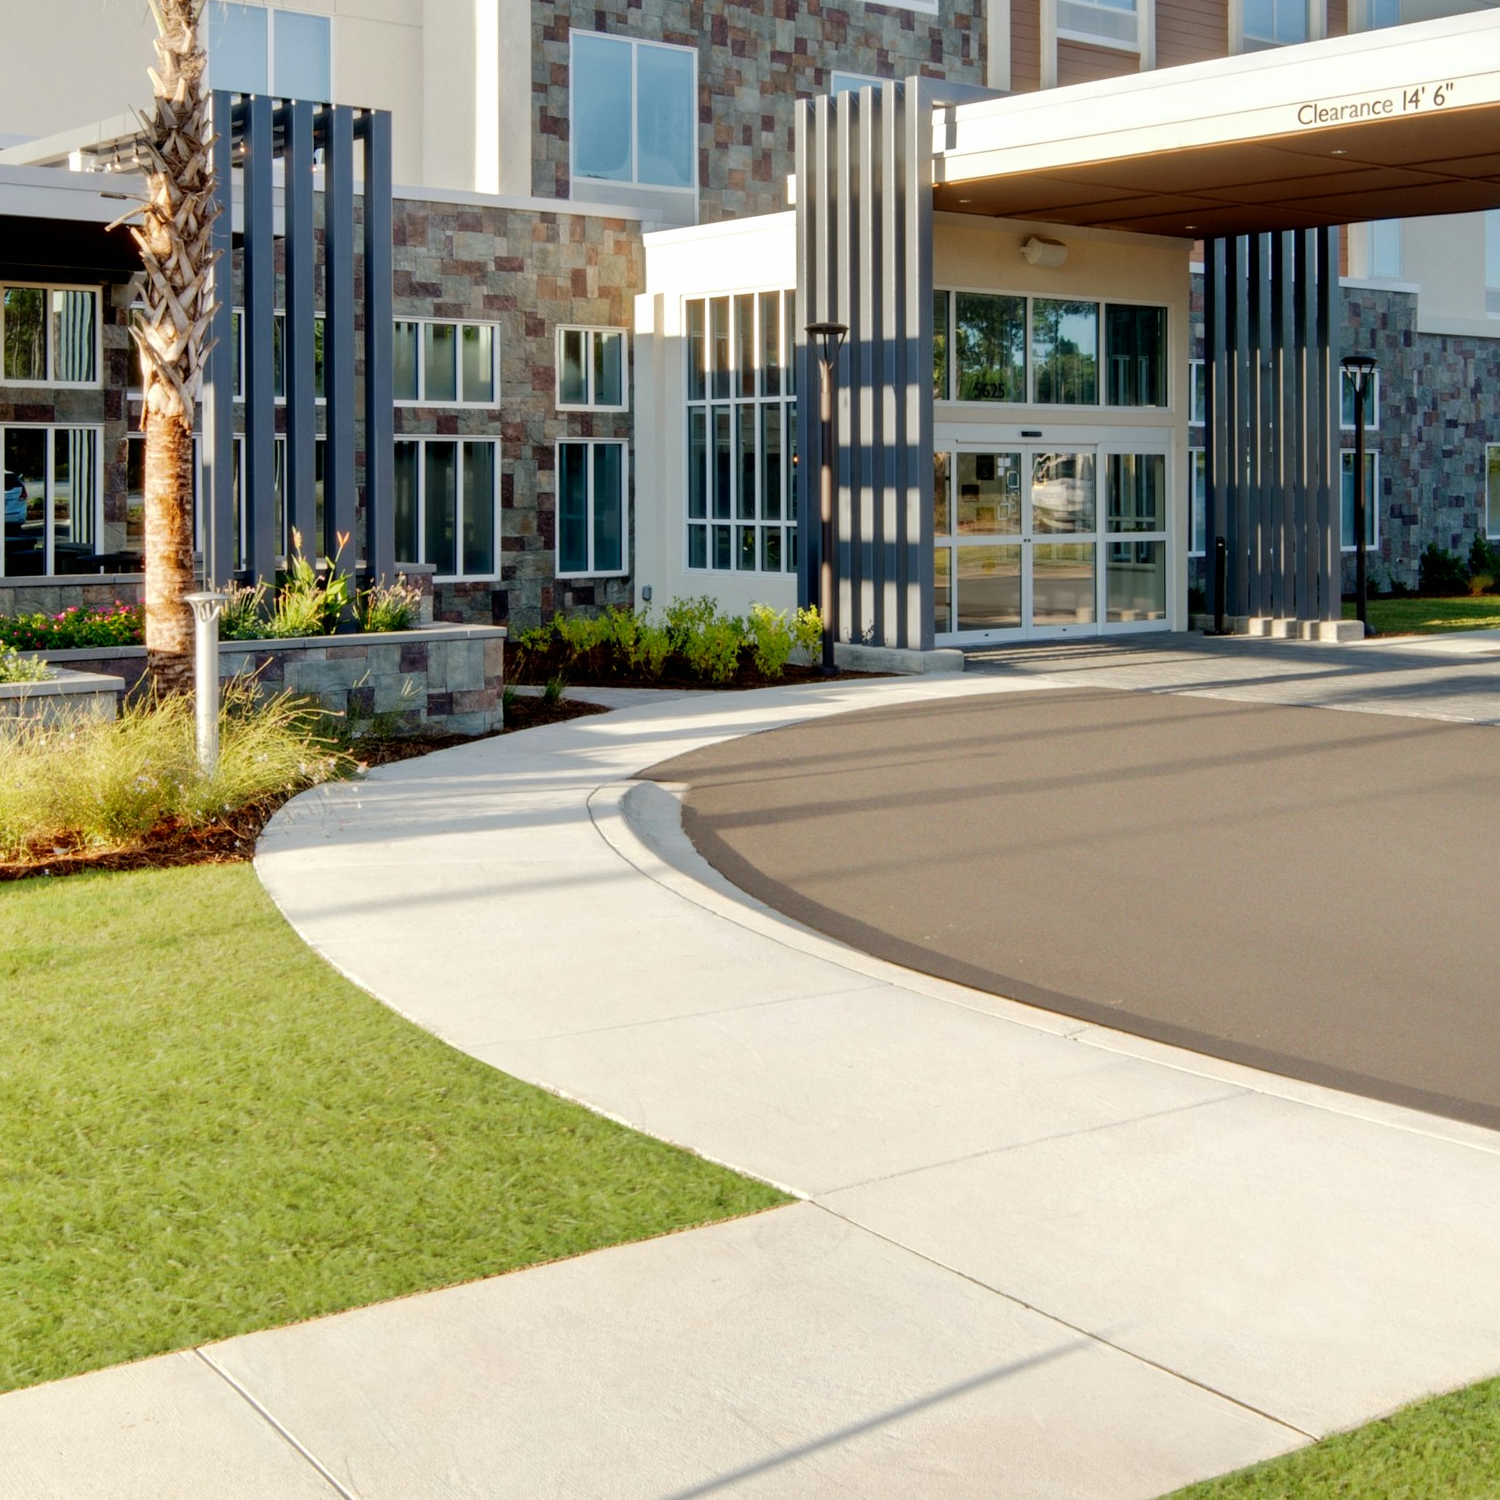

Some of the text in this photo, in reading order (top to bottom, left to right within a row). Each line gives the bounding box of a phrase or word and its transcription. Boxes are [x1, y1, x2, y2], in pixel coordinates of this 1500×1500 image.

[1297, 82, 1454, 125] Clearance 14' 6"
[973, 382, 1005, 399] 5625
